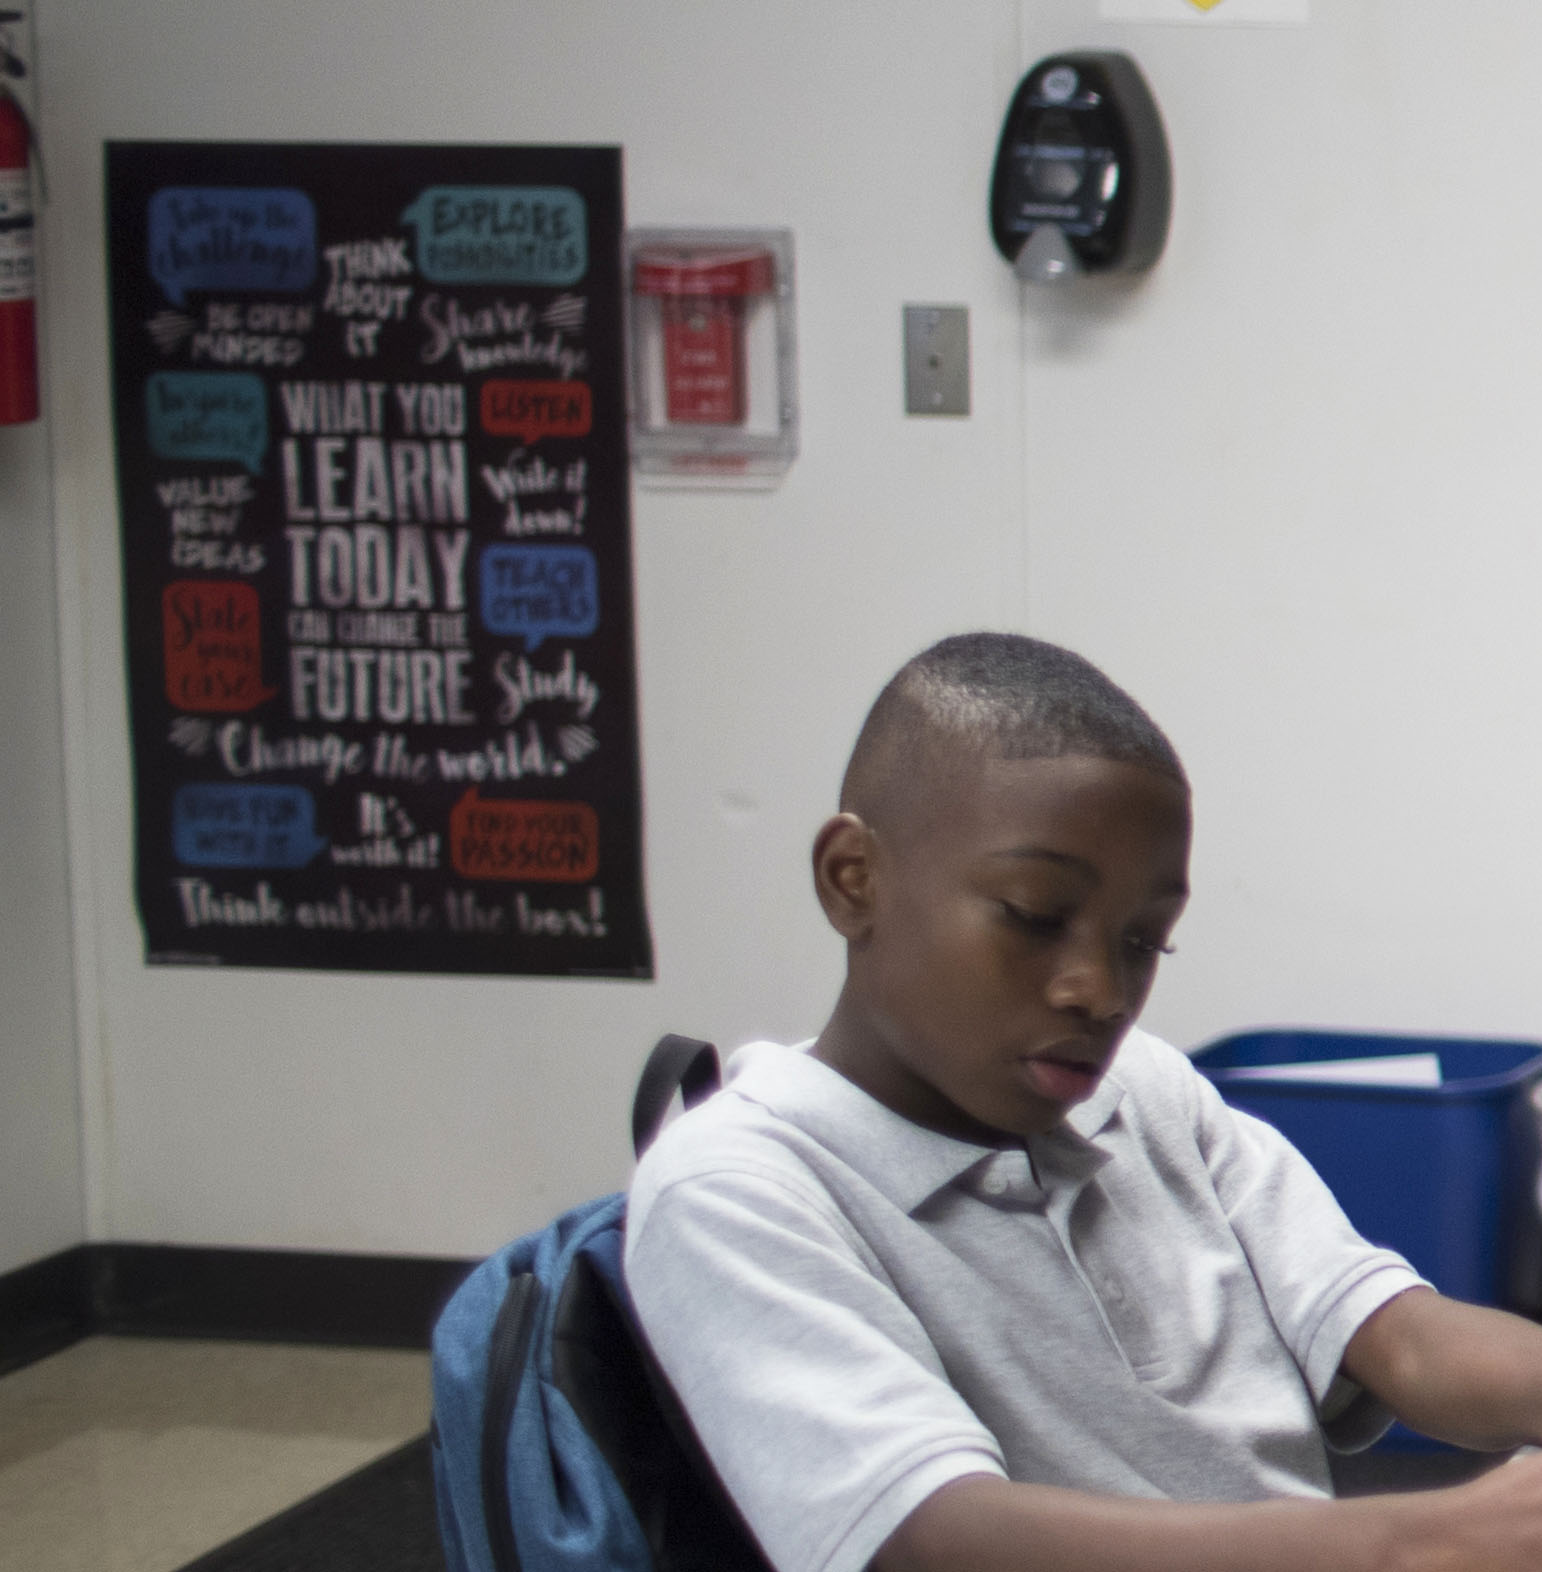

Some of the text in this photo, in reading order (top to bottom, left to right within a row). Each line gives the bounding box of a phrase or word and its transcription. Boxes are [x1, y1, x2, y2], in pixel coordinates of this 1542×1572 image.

[433, 195, 571, 241] EXPLORE
[324, 237, 413, 282] THINK
[207, 304, 240, 332] BE
[324, 282, 413, 321] ABOUT
[345, 320, 380, 359] IT
[419, 292, 536, 364] Share
[457, 332, 588, 380] knowledge
[281, 382, 466, 436] WHAT YOU
[491, 391, 584, 424] LISTEN
[156, 475, 256, 508] VALUE
[281, 436, 470, 525] LEARN
[480, 447, 560, 504] Write
[172, 507, 240, 537] NEW
[170, 538, 267, 573] IDEAS
[286, 526, 470, 610] TODAY
[287, 611, 468, 647] CAN CHANGE THE
[290, 647, 475, 725] FUTURE
[494, 649, 600, 726] Study
[217, 720, 569, 786] Change the world.
[174, 877, 286, 928] Think
[294, 884, 431, 932] outside
[444, 888, 504, 932] the
